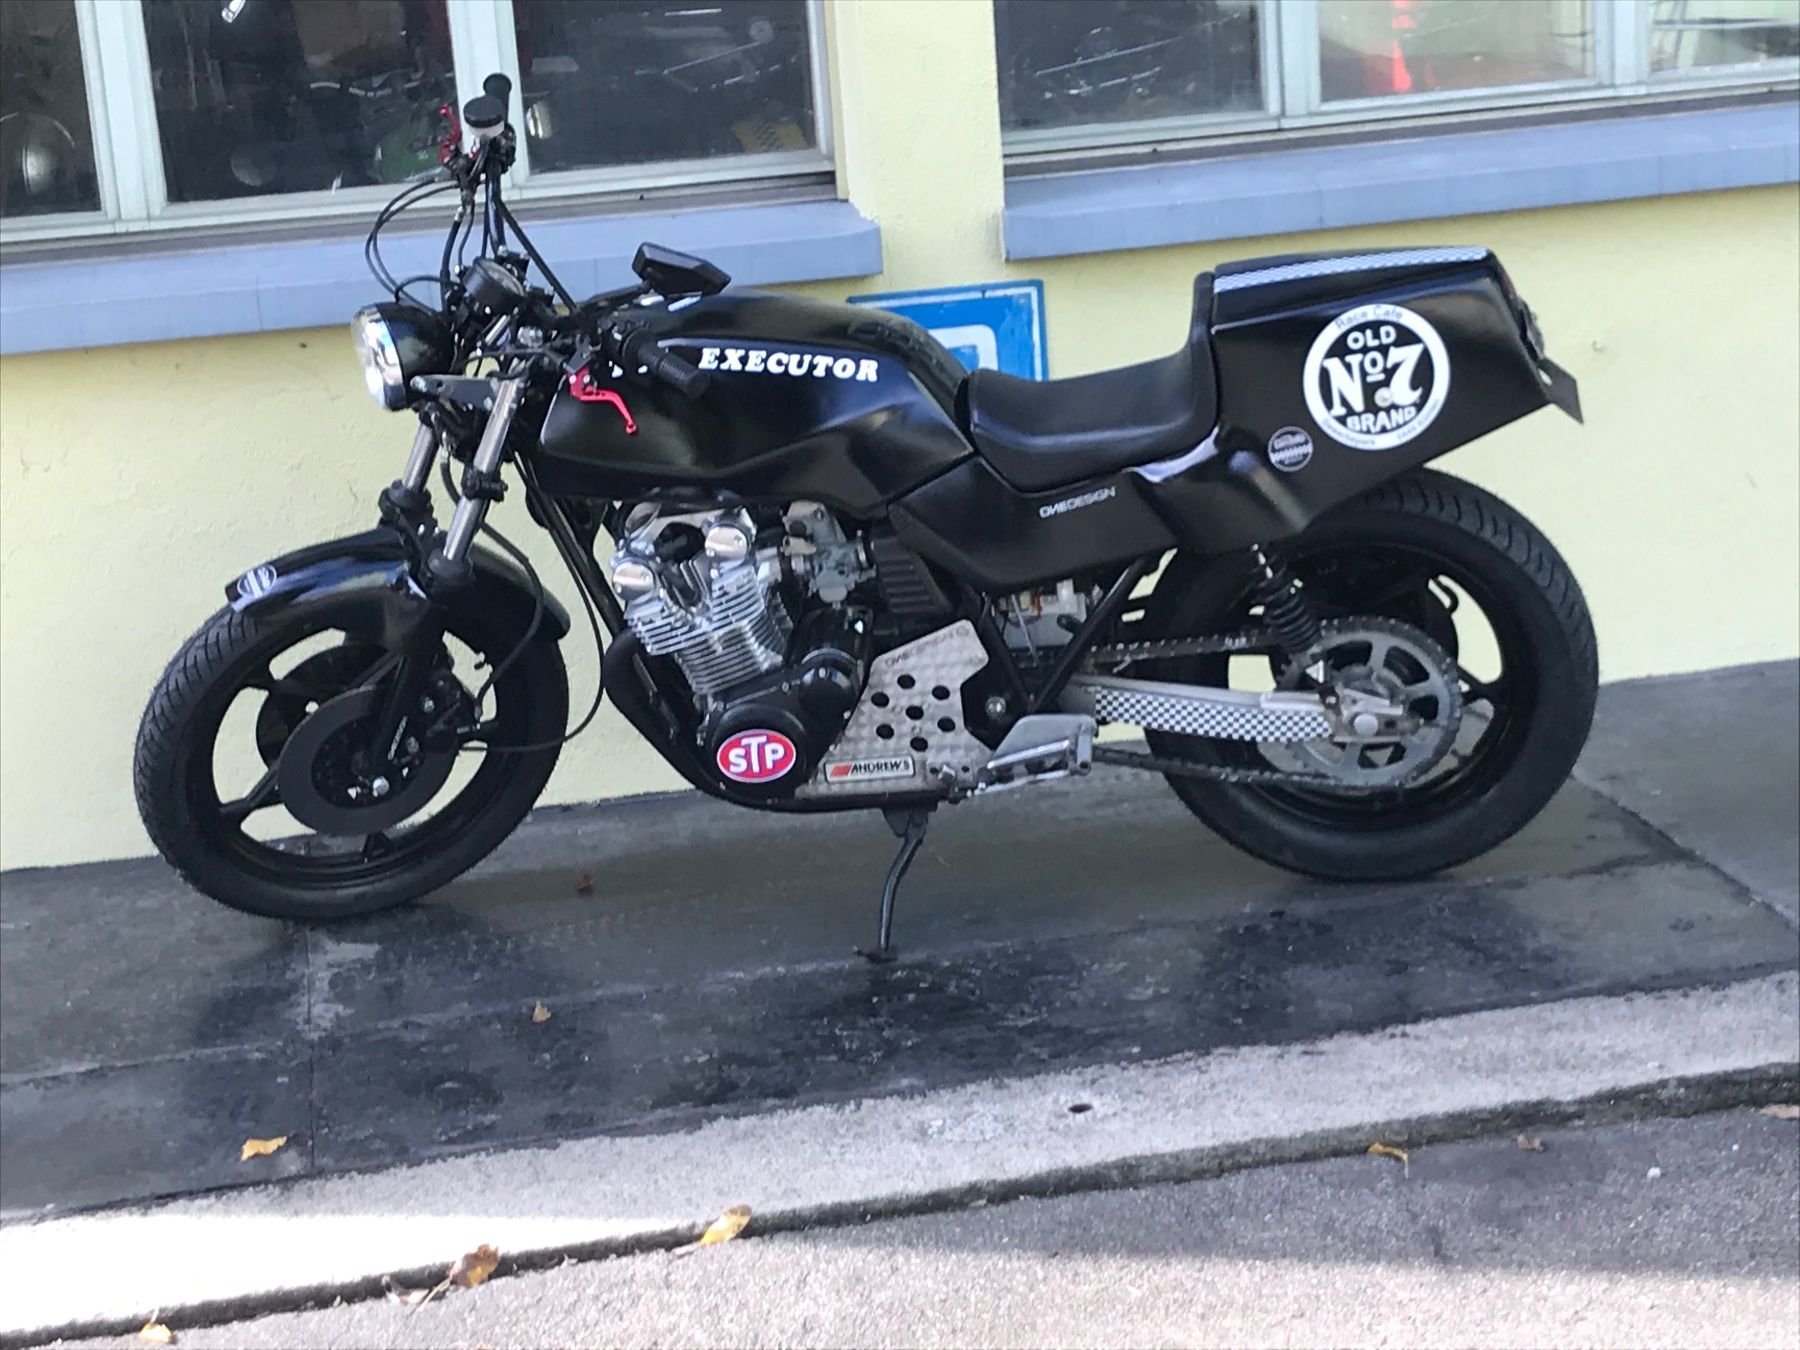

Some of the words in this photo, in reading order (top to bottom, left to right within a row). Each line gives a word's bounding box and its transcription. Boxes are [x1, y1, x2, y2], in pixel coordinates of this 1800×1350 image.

[1334, 308, 1369, 330] Race
[1347, 325, 1396, 350] OLD
[697, 347, 879, 382] EXECUTOR
[1346, 406, 1417, 434] BRAND
[728, 735, 786, 773] STP
